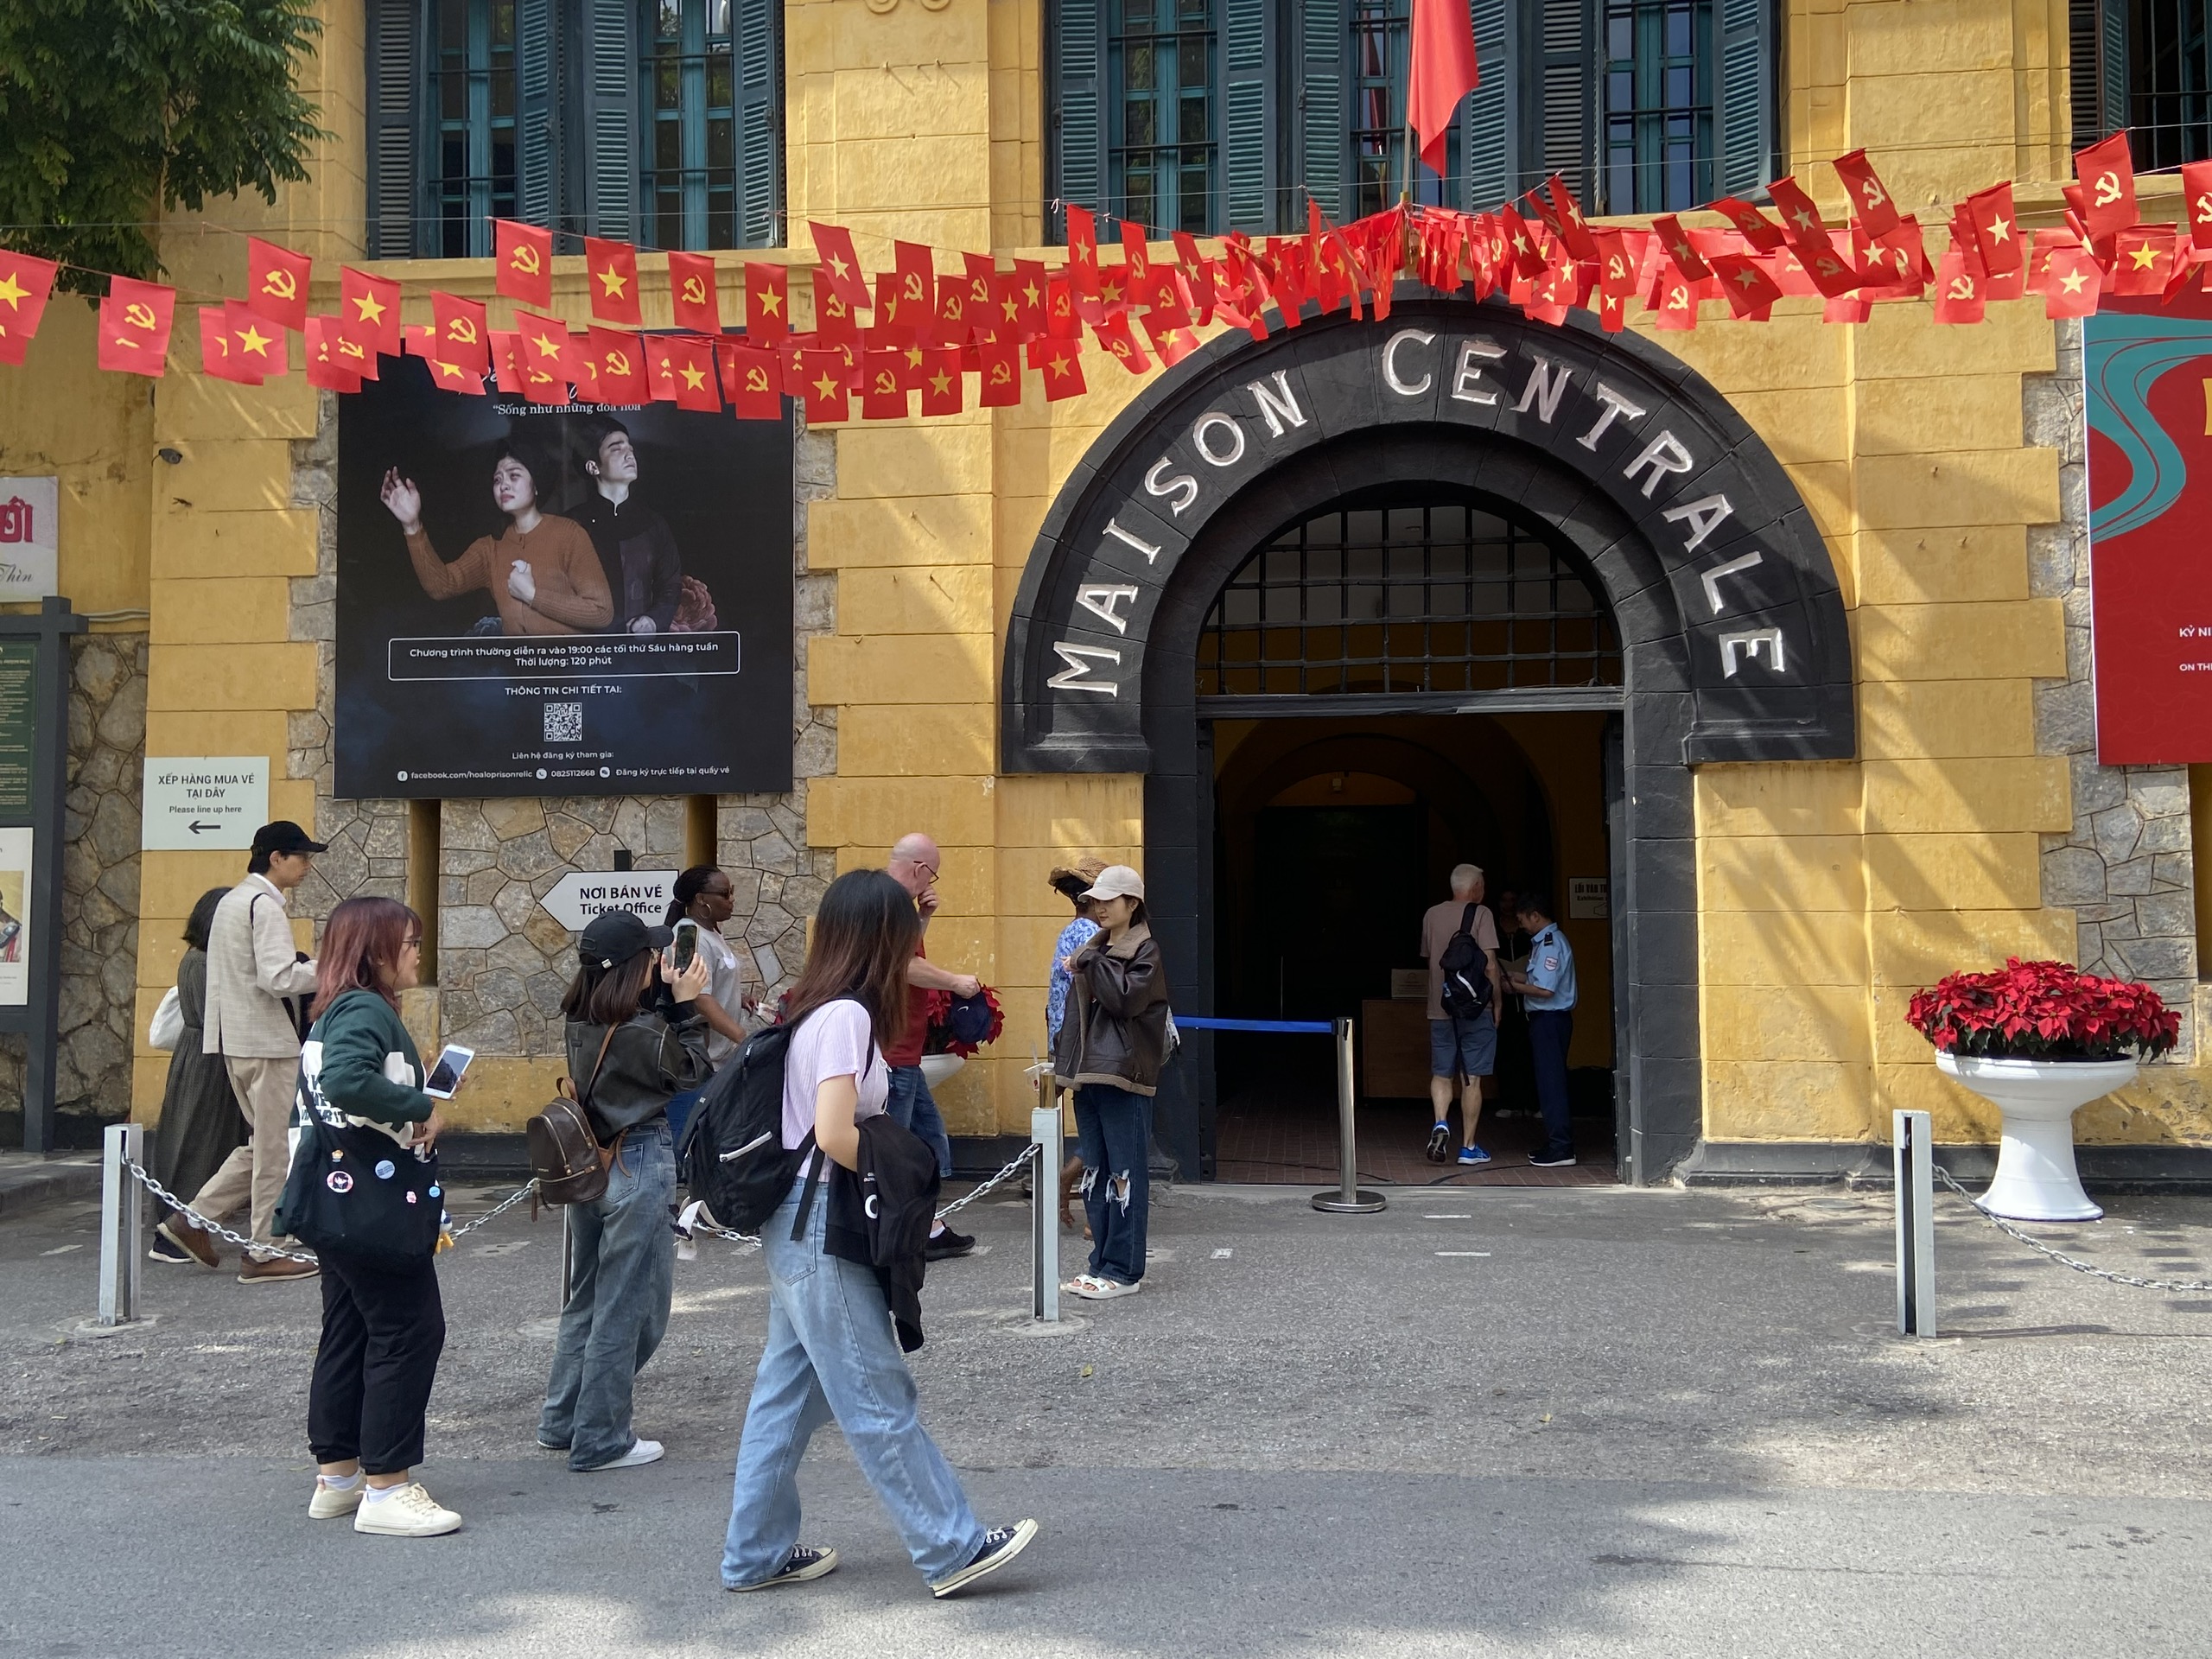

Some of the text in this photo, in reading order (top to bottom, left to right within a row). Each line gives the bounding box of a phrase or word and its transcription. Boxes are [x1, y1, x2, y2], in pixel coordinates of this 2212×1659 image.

[1047, 328, 1788, 697] MAISON CENTRALE
[2198, 627, 2211, 637] NI
[410, 648, 448, 658] Chương
[450, 648, 474, 657] trình
[475, 646, 511, 657] thường
[513, 645, 535, 656] diễn
[549, 645, 567, 655] vào
[568, 645, 593, 654] 19:00
[613, 643, 627, 653] tối
[629, 644, 646, 652] thứ
[648, 644, 666, 652] Sáu
[669, 643, 694, 653] hàng
[515, 656, 612, 668] Thời lượng: 120 phút
[2196, 663, 2212, 671] TH
[505, 683, 622, 696] THÔNG TIN CHI TIẾT TẠI:
[531, 752, 541, 760] hệ
[543, 751, 563, 760] đăng
[565, 751, 576, 760] ký
[576, 750, 598, 759] tham
[599, 750, 614, 760] gia:
[158, 772, 255, 785] XẾP HÀNG MUA VÉ
[410, 770, 533, 779] facebook.com/hoaloprisonrelic
[550, 769, 595, 778] 0825112668
[615, 768, 639, 778] Đăng
[639, 766, 649, 777] ký
[650, 766, 668, 777] trực
[669, 766, 685, 776] tiếp
[686, 766, 697, 776] tại
[186, 786, 226, 800] TẠI ĐÂY
[168, 805, 195, 814] Please
[196, 805, 212, 814] line
[225, 804, 243, 813] here
[579, 884, 663, 899] NƠI BÁN VÉ
[623, 902, 662, 914] Office
